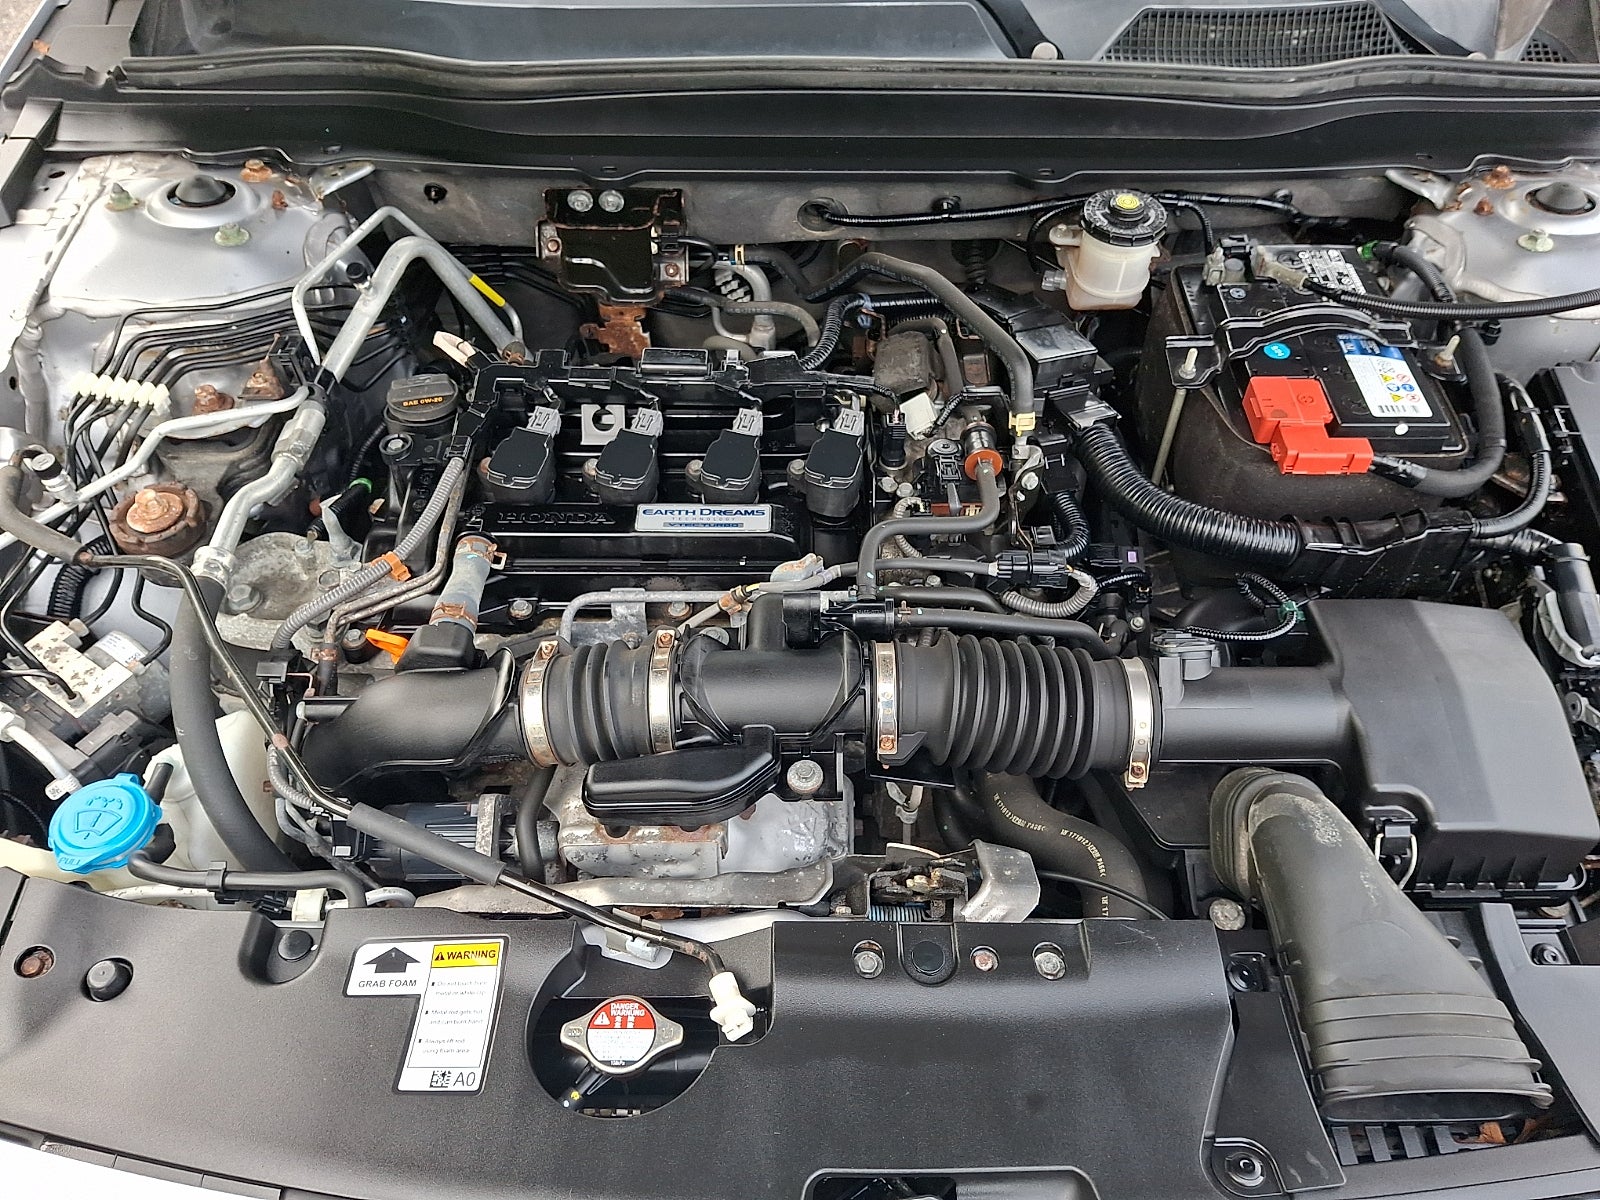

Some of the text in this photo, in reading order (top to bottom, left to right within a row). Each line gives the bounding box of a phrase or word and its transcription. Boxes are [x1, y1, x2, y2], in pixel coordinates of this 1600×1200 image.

[642, 508, 766, 516] EARTH DREAMS
[497, 511, 617, 524] HONDA
[58, 856, 80, 865] PULL
[447, 949, 496, 961] WARNING
[358, 979, 417, 988] GRAB FOAM
[610, 1002, 640, 1010] DANGER
[453, 1071, 476, 1087] A0
